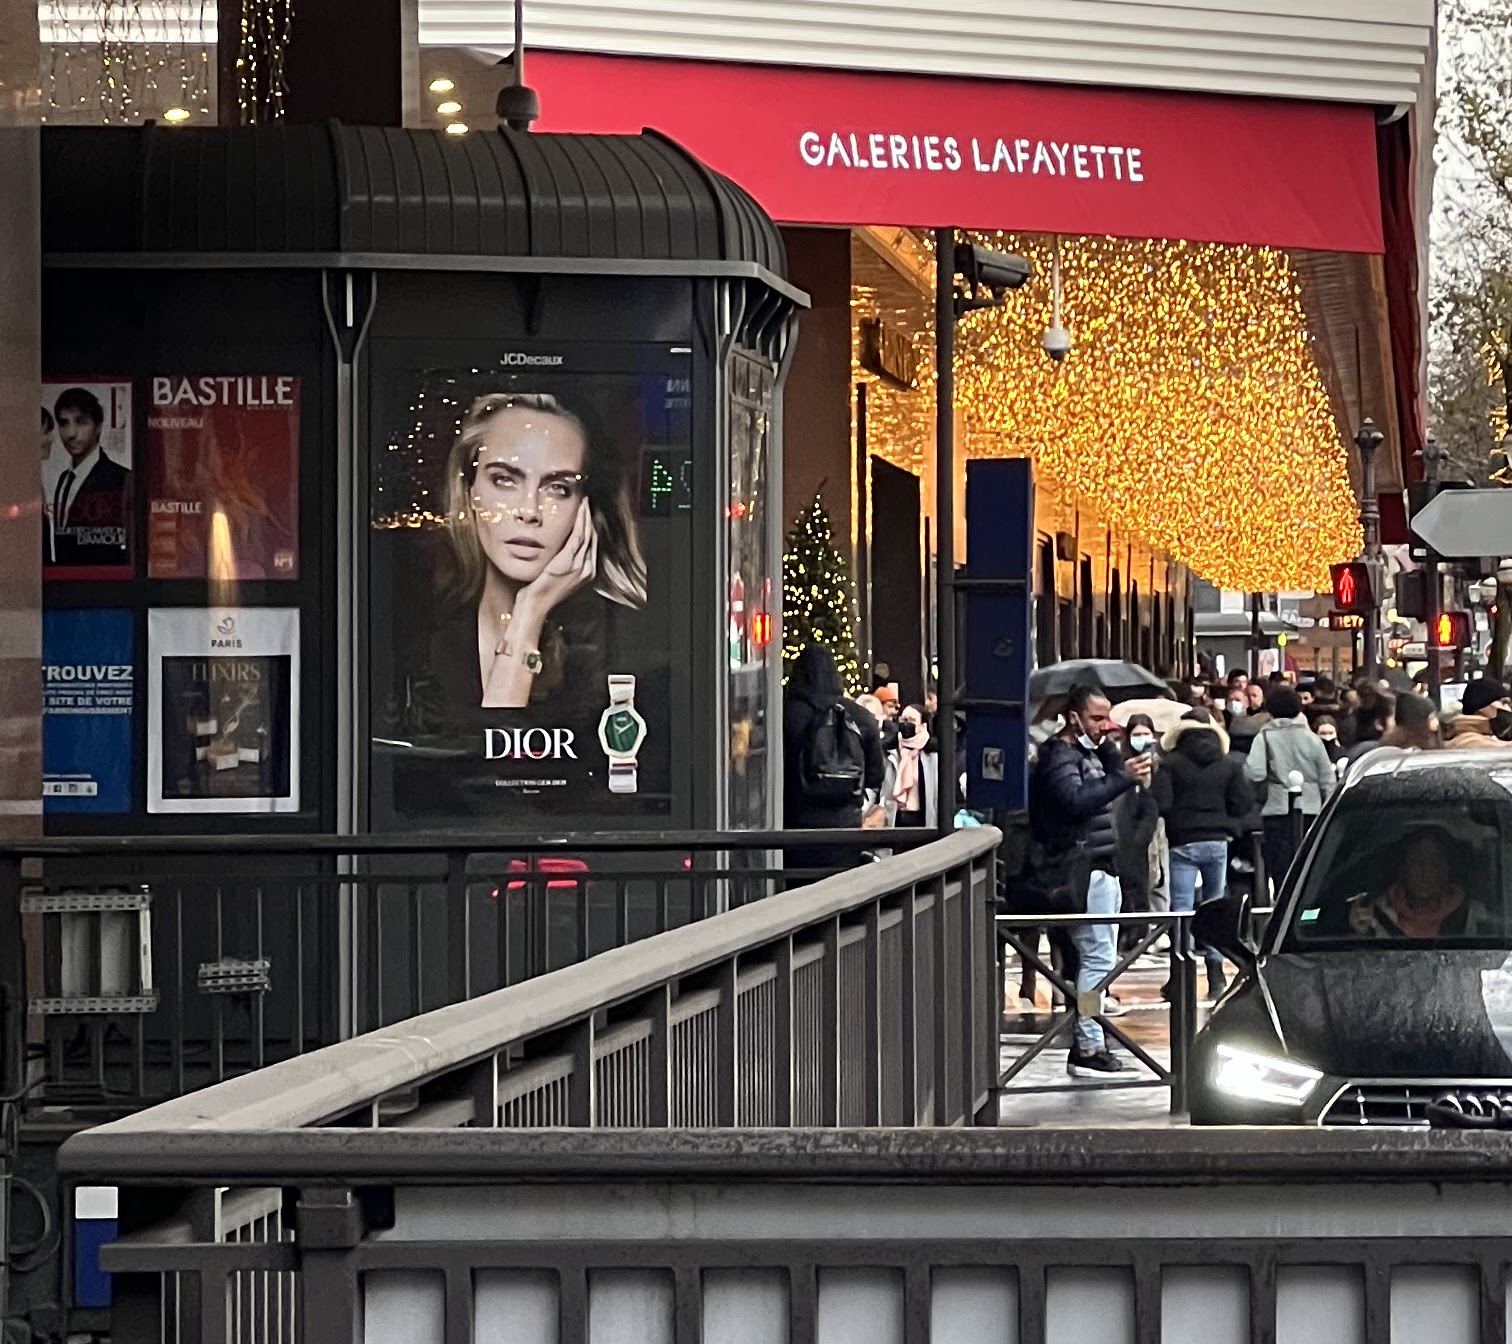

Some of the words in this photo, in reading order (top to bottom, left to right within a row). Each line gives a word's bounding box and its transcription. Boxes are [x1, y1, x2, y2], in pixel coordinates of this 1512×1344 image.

[798, 130, 962, 171] GALERIES
[971, 137, 1145, 183] LAFAYETTE
[500, 352, 564, 366] JCDecaux
[152, 375, 294, 406] BASTILLE
[150, 501, 202, 514] BASTILLE
[211, 639, 243, 648] PARIS
[42, 665, 134, 681] ROUVEZ
[484, 727, 579, 760] DIOR
